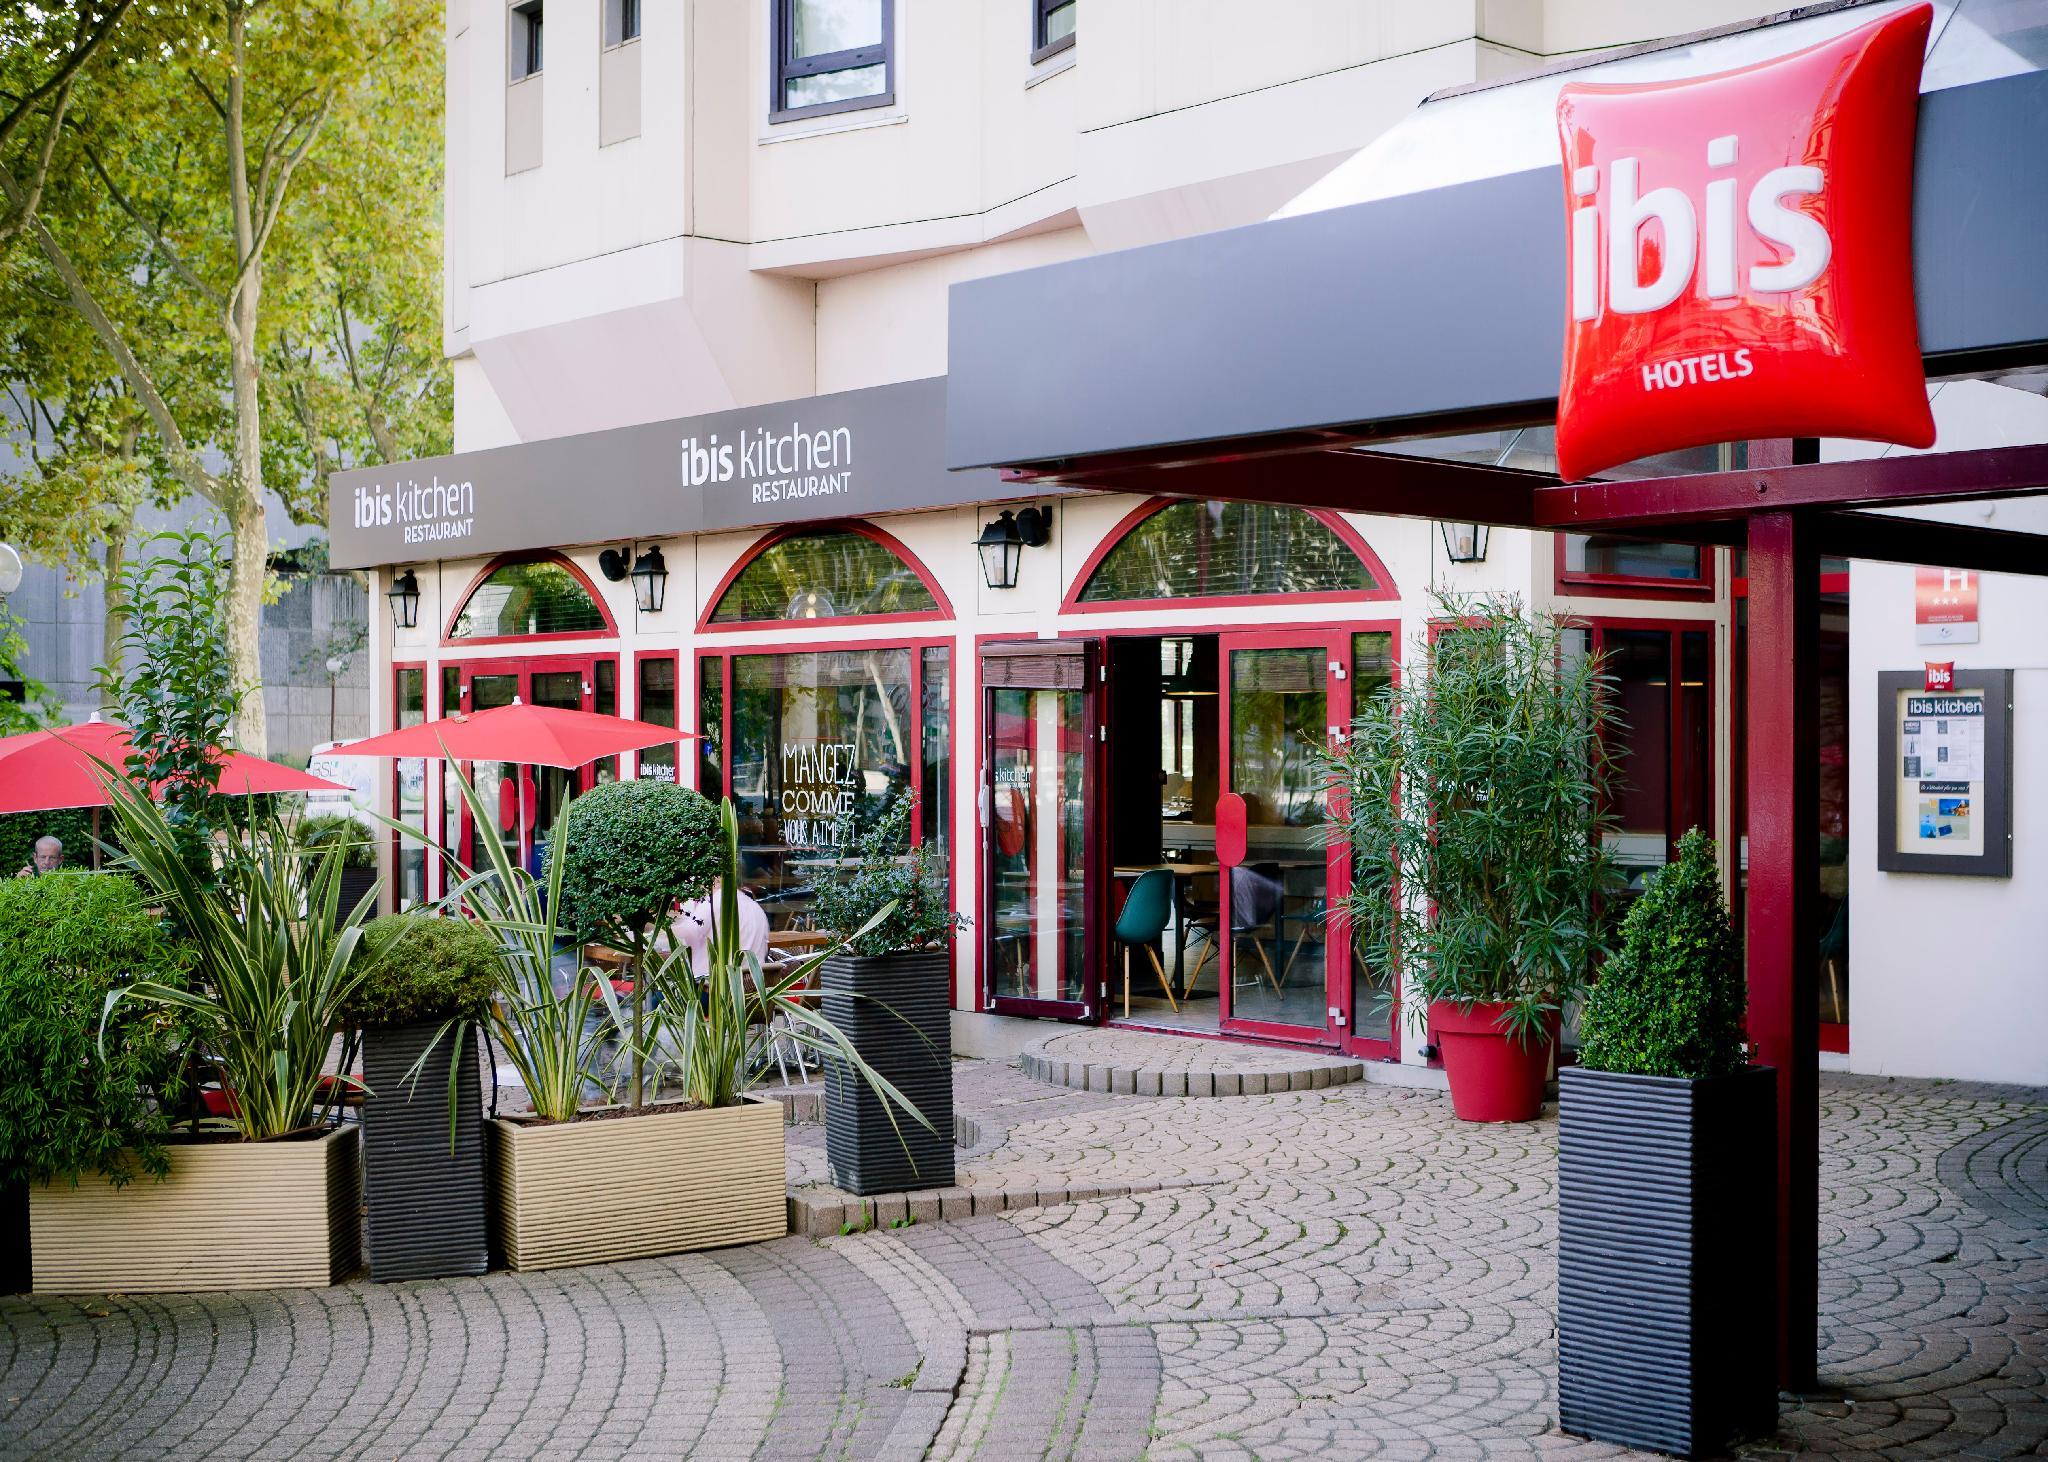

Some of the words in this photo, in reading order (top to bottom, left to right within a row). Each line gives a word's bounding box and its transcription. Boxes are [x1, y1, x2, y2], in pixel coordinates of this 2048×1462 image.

[1573, 134, 1832, 322] ibis
[1641, 348, 1753, 391] HOTELS
[680, 434, 734, 487] ibis
[740, 422, 851, 479] kitchen
[752, 472, 852, 504] RESTAURANT
[354, 484, 392, 529] ibis
[396, 476, 473, 524] kitchen
[404, 518, 474, 544] RESTAURANT
[1943, 569, 1969, 592] H
[1928, 668, 1951, 683] ibis
[1910, 699, 1933, 714] ibis
[1934, 698, 1983, 714] kitchen
[640, 763, 653, 776] ibis
[783, 743, 856, 785] MANGEZ
[999, 767, 1031, 782] kitchen
[782, 789, 855, 815] COMME
[783, 818, 808, 845] VOUS
